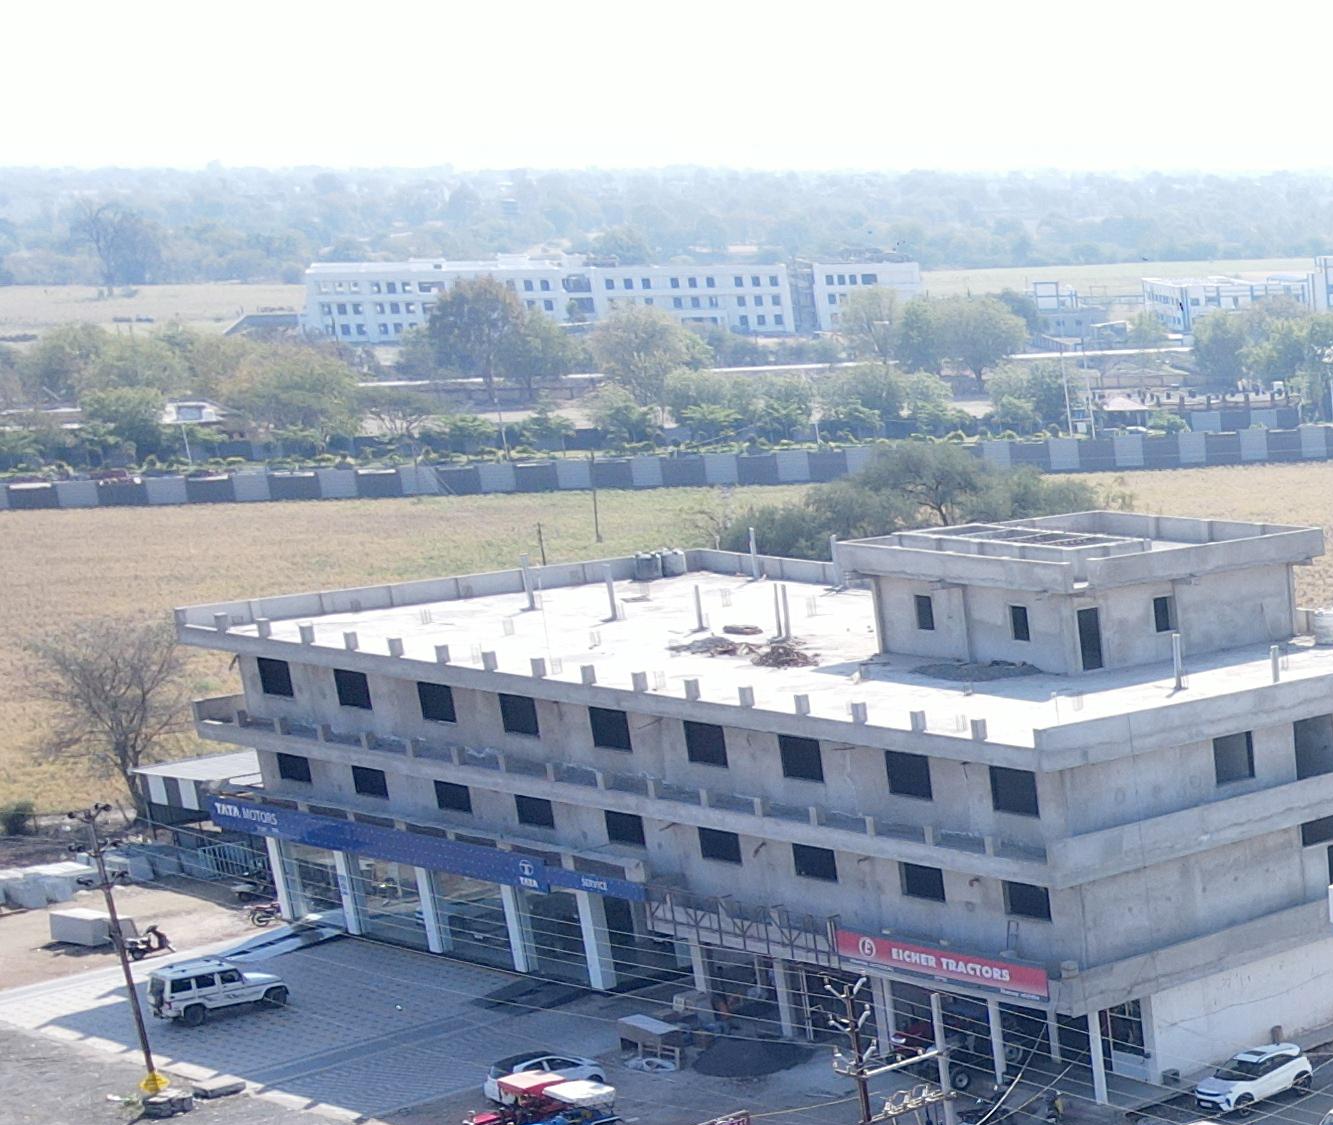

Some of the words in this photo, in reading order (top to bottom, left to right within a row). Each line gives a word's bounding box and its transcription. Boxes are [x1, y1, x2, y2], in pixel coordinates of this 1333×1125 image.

[214, 802, 240, 818] TATA
[242, 809, 278, 826] MOTORS
[891, 948, 937, 968] EICHER
[940, 957, 1010, 982] TRACTORS
